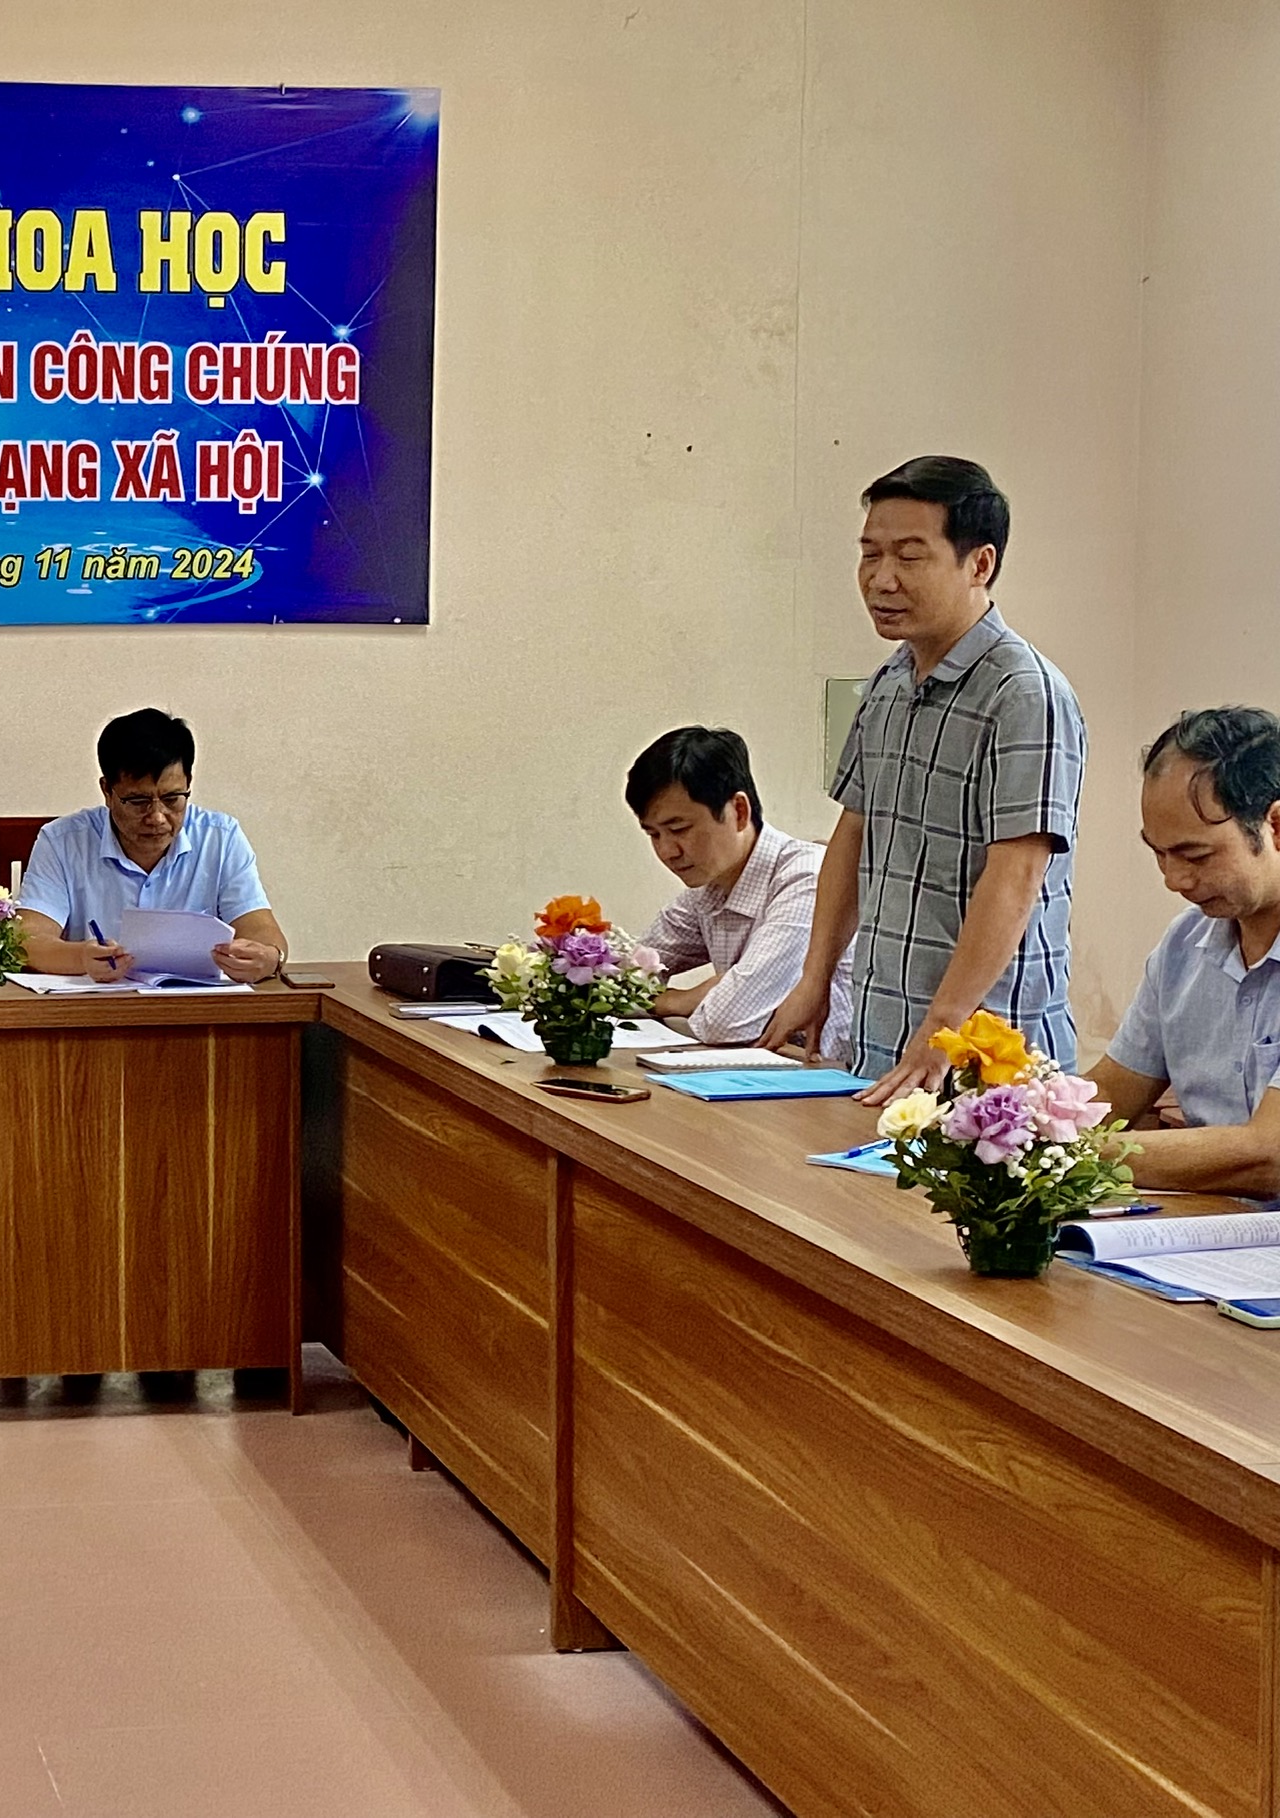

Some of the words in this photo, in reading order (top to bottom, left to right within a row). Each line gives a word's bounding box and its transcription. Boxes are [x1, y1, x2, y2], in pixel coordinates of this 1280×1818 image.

[138, 210, 287, 309] HỌC
[30, 328, 173, 404] CÔNG
[185, 330, 360, 405] CHÚNG
[111, 428, 186, 502] XÃ
[195, 429, 283, 515] HỘI
[35, 549, 69, 580] 11
[82, 548, 160, 580] năm
[172, 548, 256, 580] 2024
